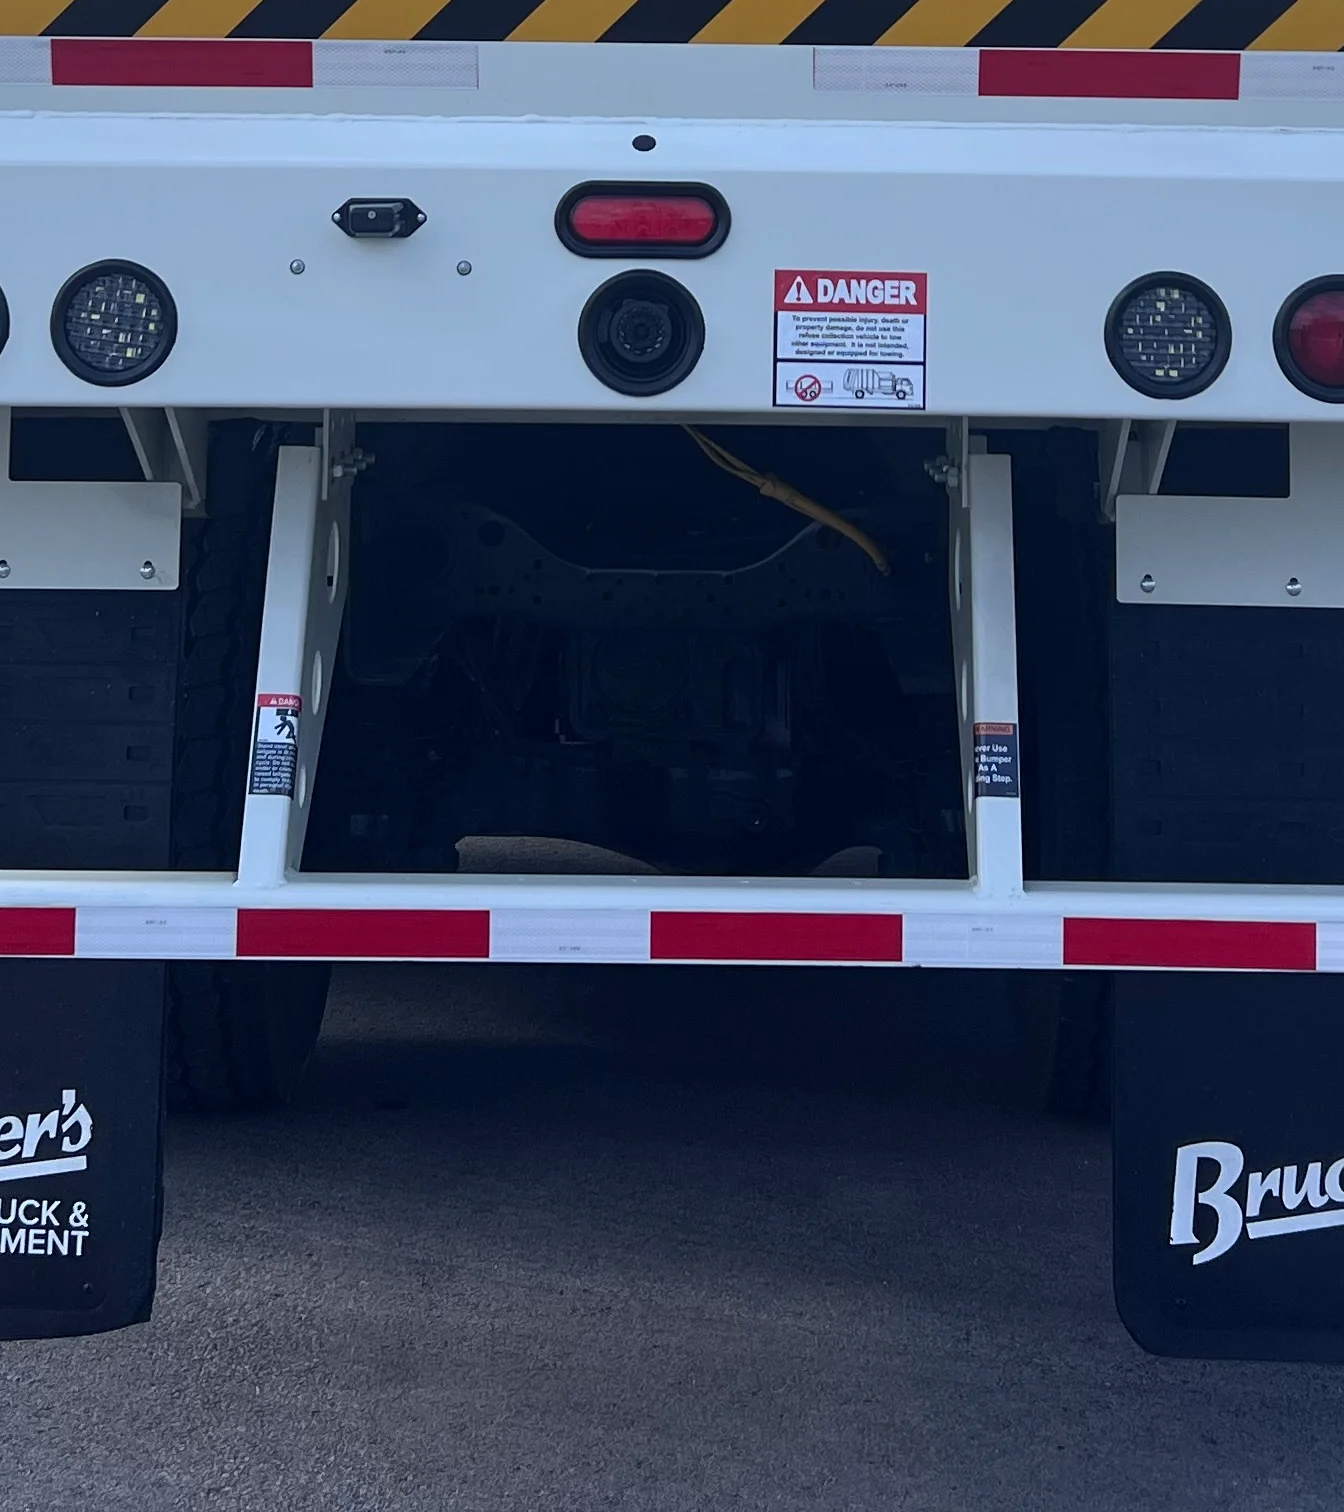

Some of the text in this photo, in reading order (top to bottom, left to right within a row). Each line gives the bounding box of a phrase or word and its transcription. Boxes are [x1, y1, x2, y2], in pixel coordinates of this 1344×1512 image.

[817, 279, 917, 305] DANGER
[976, 725, 1010, 733] ARNING
[992, 744, 1008, 752] Use
[980, 754, 1012, 764] Bumper
[992, 774, 1012, 784] Step.
[67, 1201, 89, 1227] &
